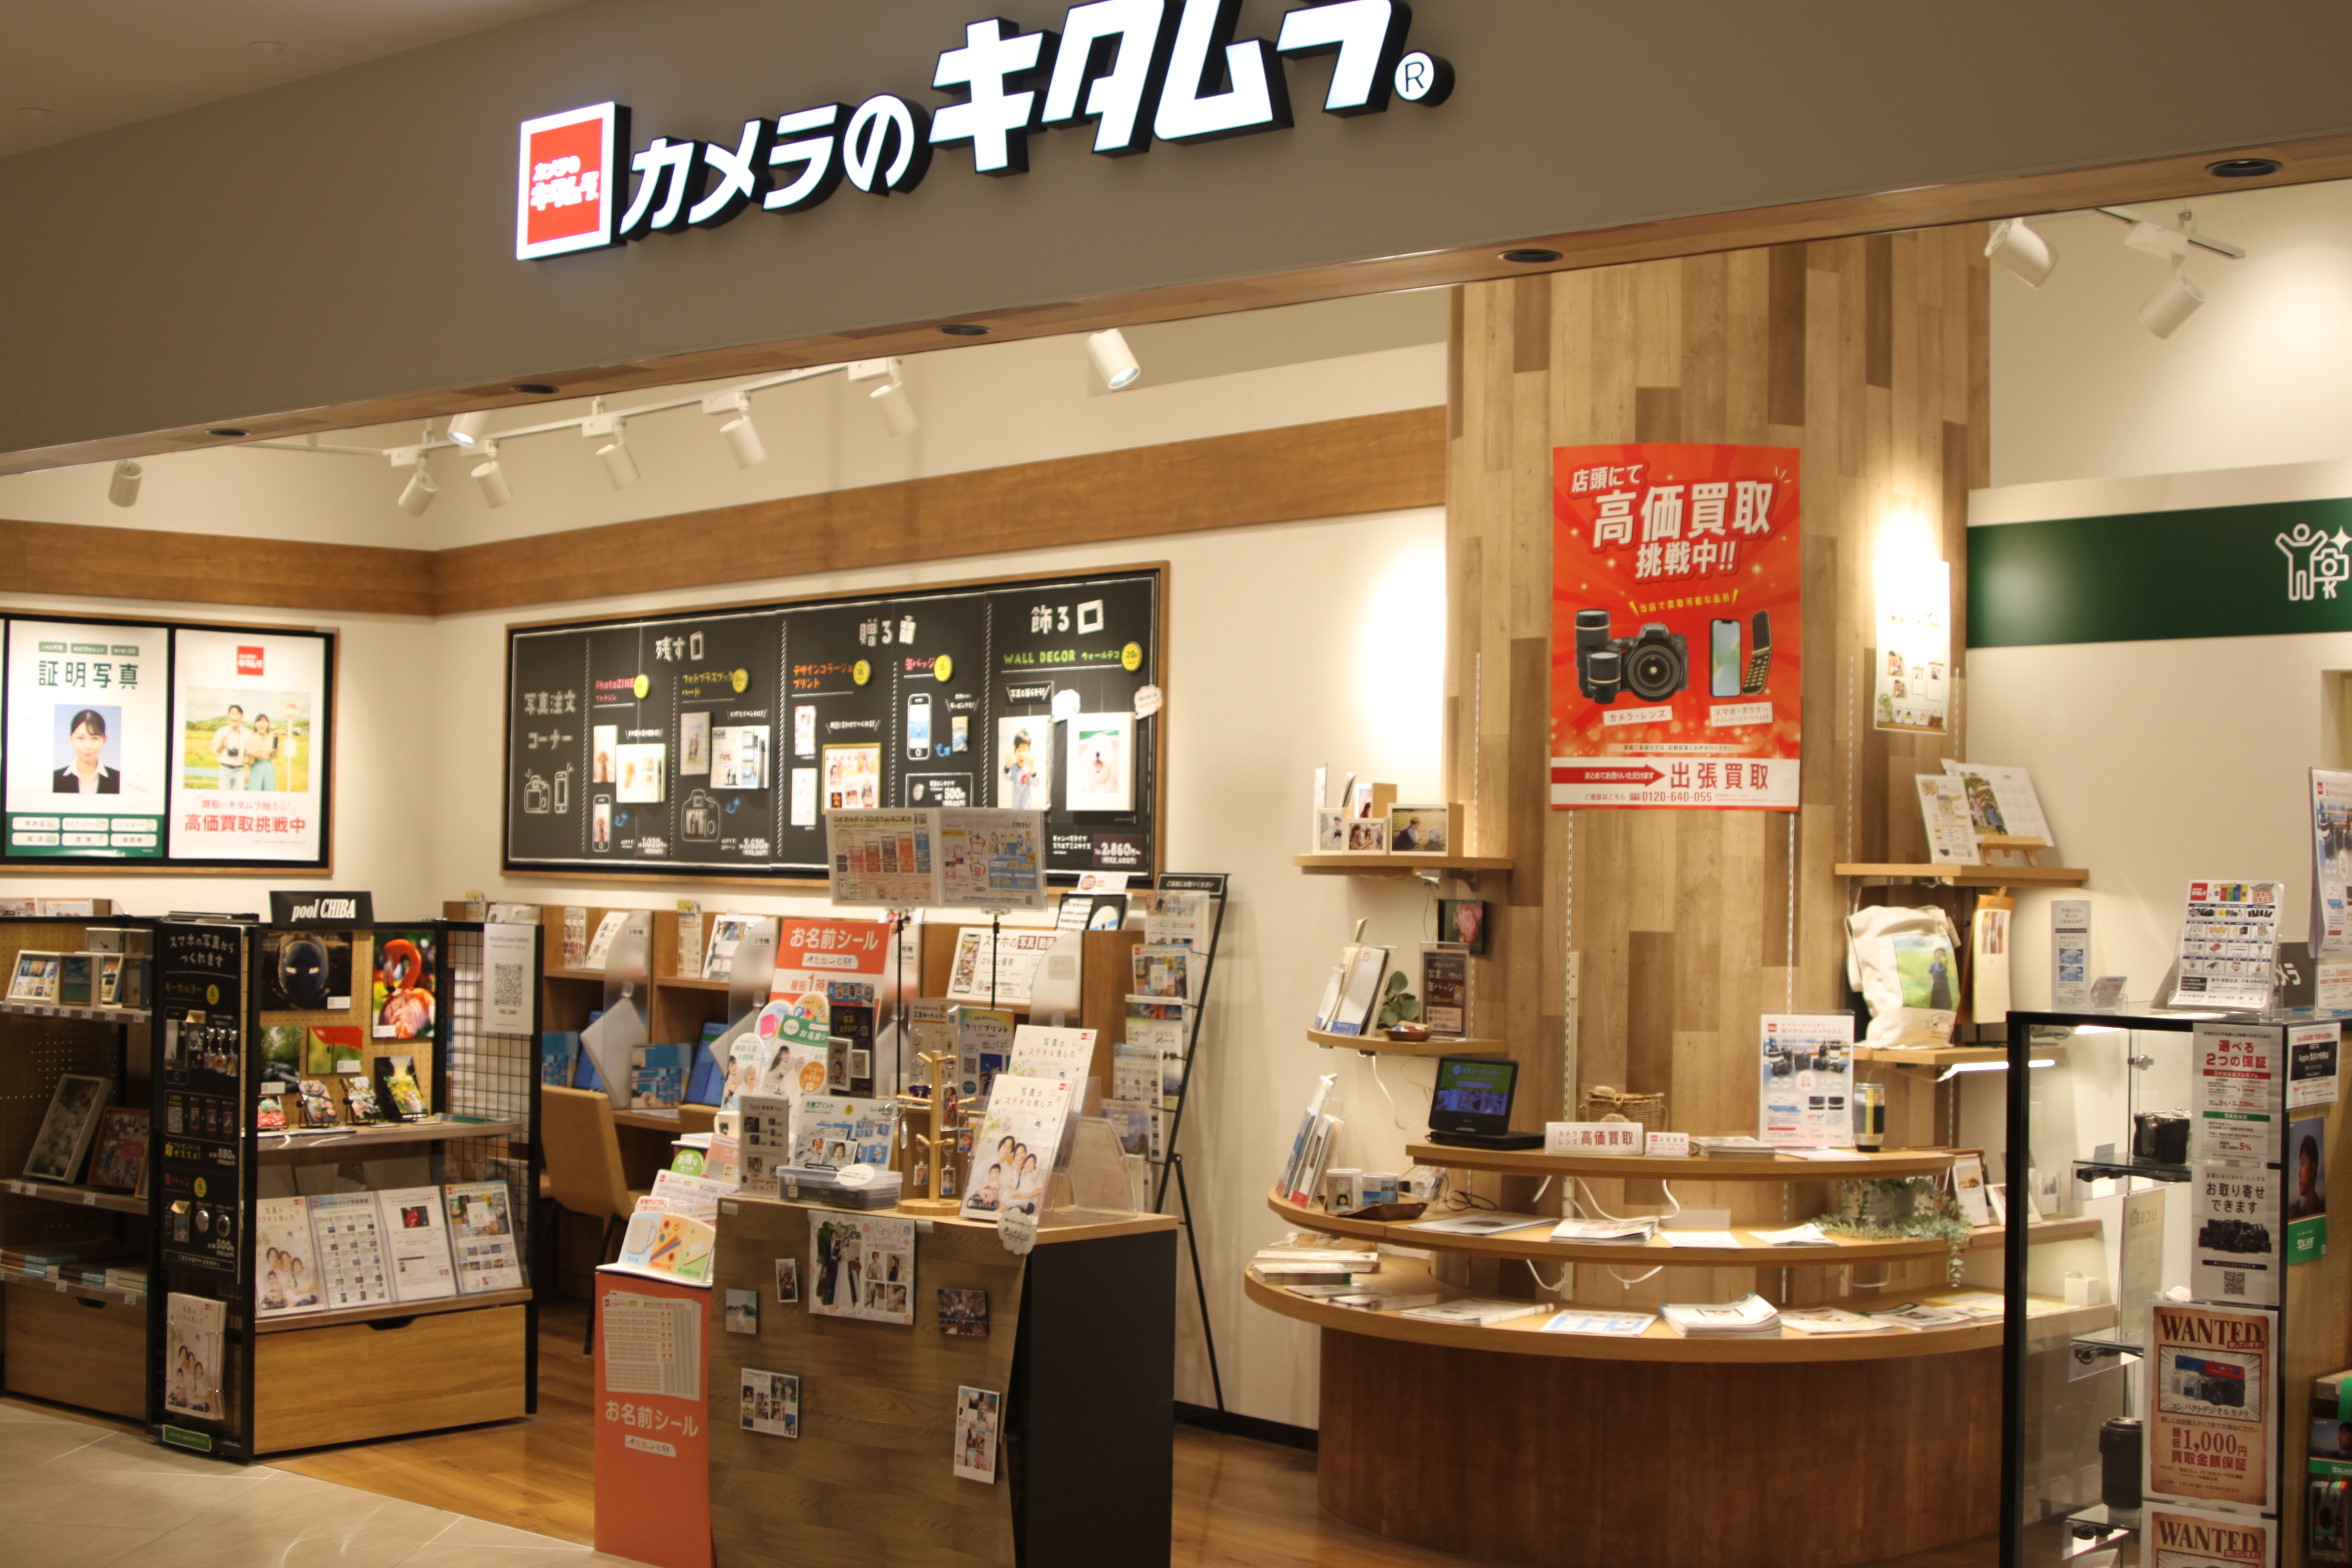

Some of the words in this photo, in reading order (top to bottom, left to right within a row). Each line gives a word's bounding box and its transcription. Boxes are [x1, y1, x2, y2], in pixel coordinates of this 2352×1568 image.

[1572, 464, 1644, 492] 店頭にて
[1593, 480, 1773, 548] 高価買取
[1031, 605, 1070, 635] 飾る
[859, 619, 894, 647] 贈る
[655, 636, 686, 662] 残す
[1003, 652, 1035, 666] WALL
[1040, 649, 1075, 663] DECOR
[38, 660, 140, 689] 証明写真
[793, 679, 820, 690] プリント
[524, 690, 577, 716] 写真注文
[527, 729, 574, 751] コーナー
[1671, 762, 1769, 790] 出張買取
[1642, 791, 1712, 802] 0120-640-055
[185, 814, 305, 834] 高価買取挑戦中
[290, 899, 318, 922] pool
[320, 898, 357, 919] CHIBA
[169, 933, 235, 953] スマホの写真から
[790, 927, 879, 951] お名前シール
[180, 951, 223, 969] つくれます
[2218, 1040, 2254, 1053] 選べる
[2206, 1053, 2268, 1069] 2つの保証
[1558, 1130, 1578, 1138] カメラ
[1581, 1130, 1634, 1146] 高価買取
[1558, 1138, 1579, 1146] レンズ
[2239, 1142, 2253, 1152] 5%
[2205, 1182, 2266, 1200] お取り寄せ
[2211, 1199, 2259, 1214] できます
[2160, 1314, 2263, 1346] WANTED
[605, 1400, 699, 1438] お名前シール
[2169, 1402, 2250, 1418] コンパクトデジタルカメラ
[2183, 1429, 2248, 1457] 1,000円
[2171, 1450, 2248, 1472] 買取金額保証
[2158, 1520, 2260, 1553] WANTED
